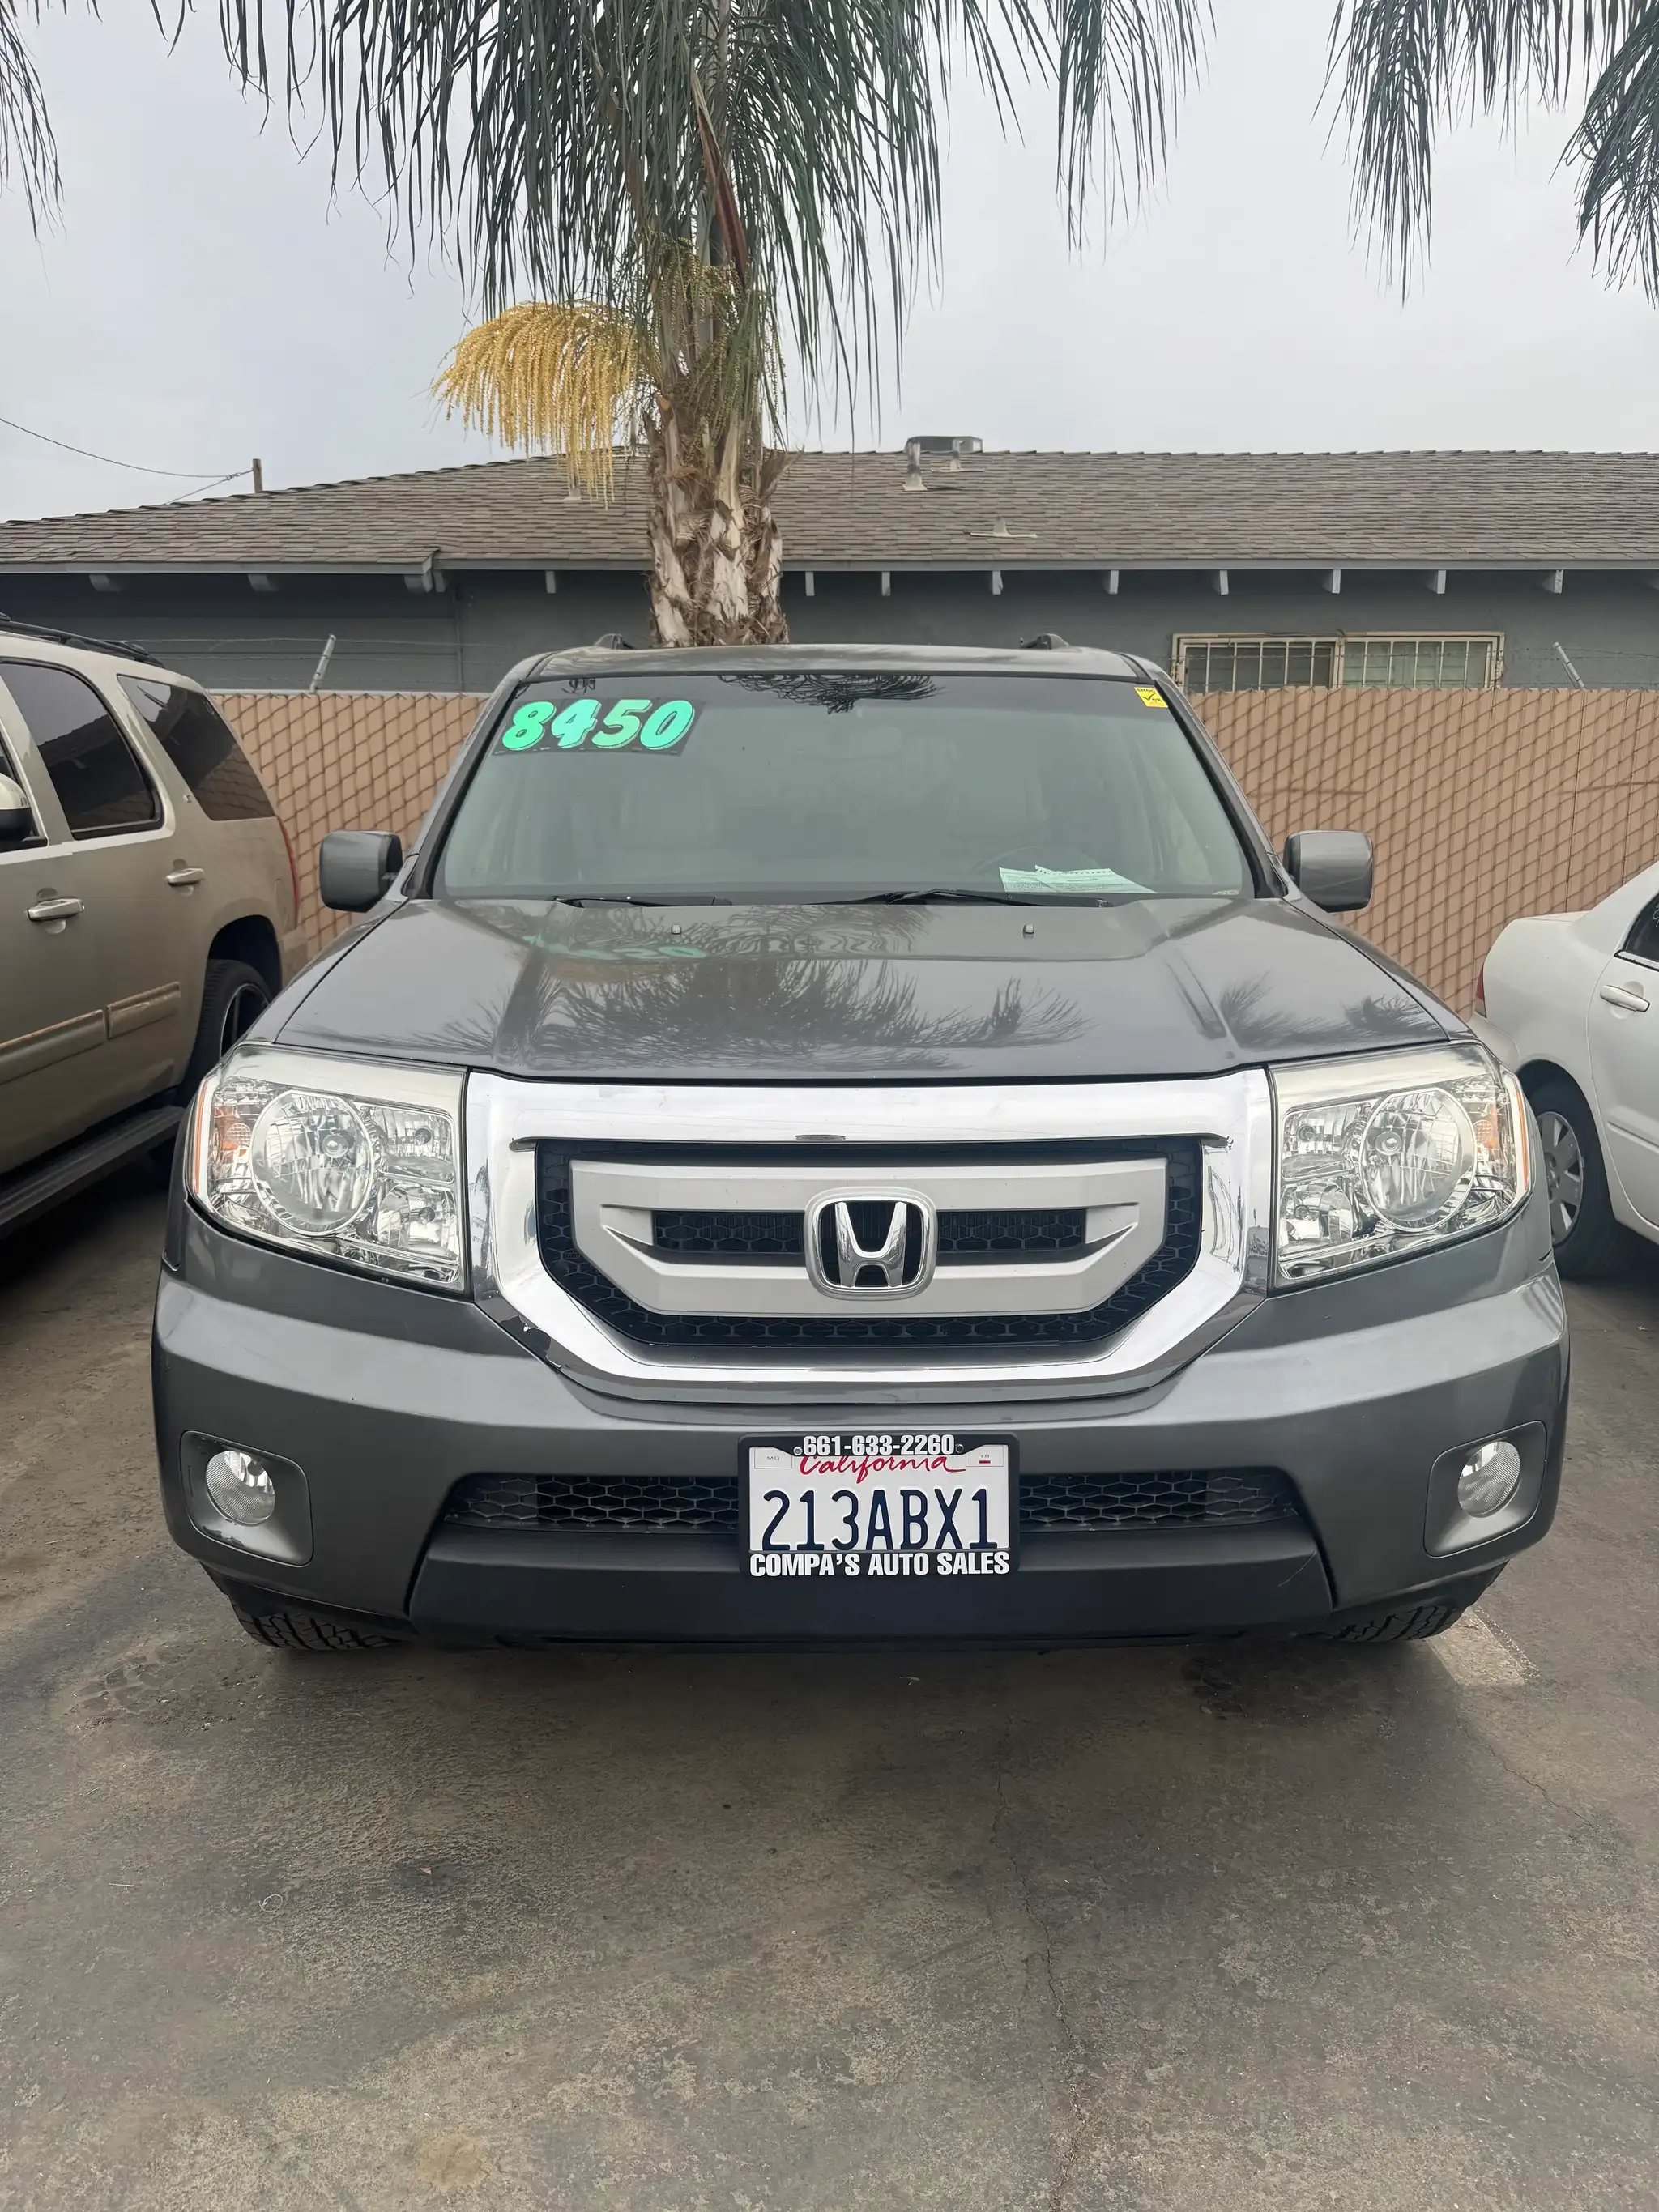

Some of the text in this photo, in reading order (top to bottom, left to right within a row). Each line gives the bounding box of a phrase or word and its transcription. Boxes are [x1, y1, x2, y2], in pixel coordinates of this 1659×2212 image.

[502, 699, 695, 750] 8450
[803, 1434, 954, 1456] 661-633-2260
[800, 1455, 966, 1484] California
[761, 1488, 998, 1550] 213ABX1
[749, 1551, 1009, 1576] COMPA'S AUTO SALES
